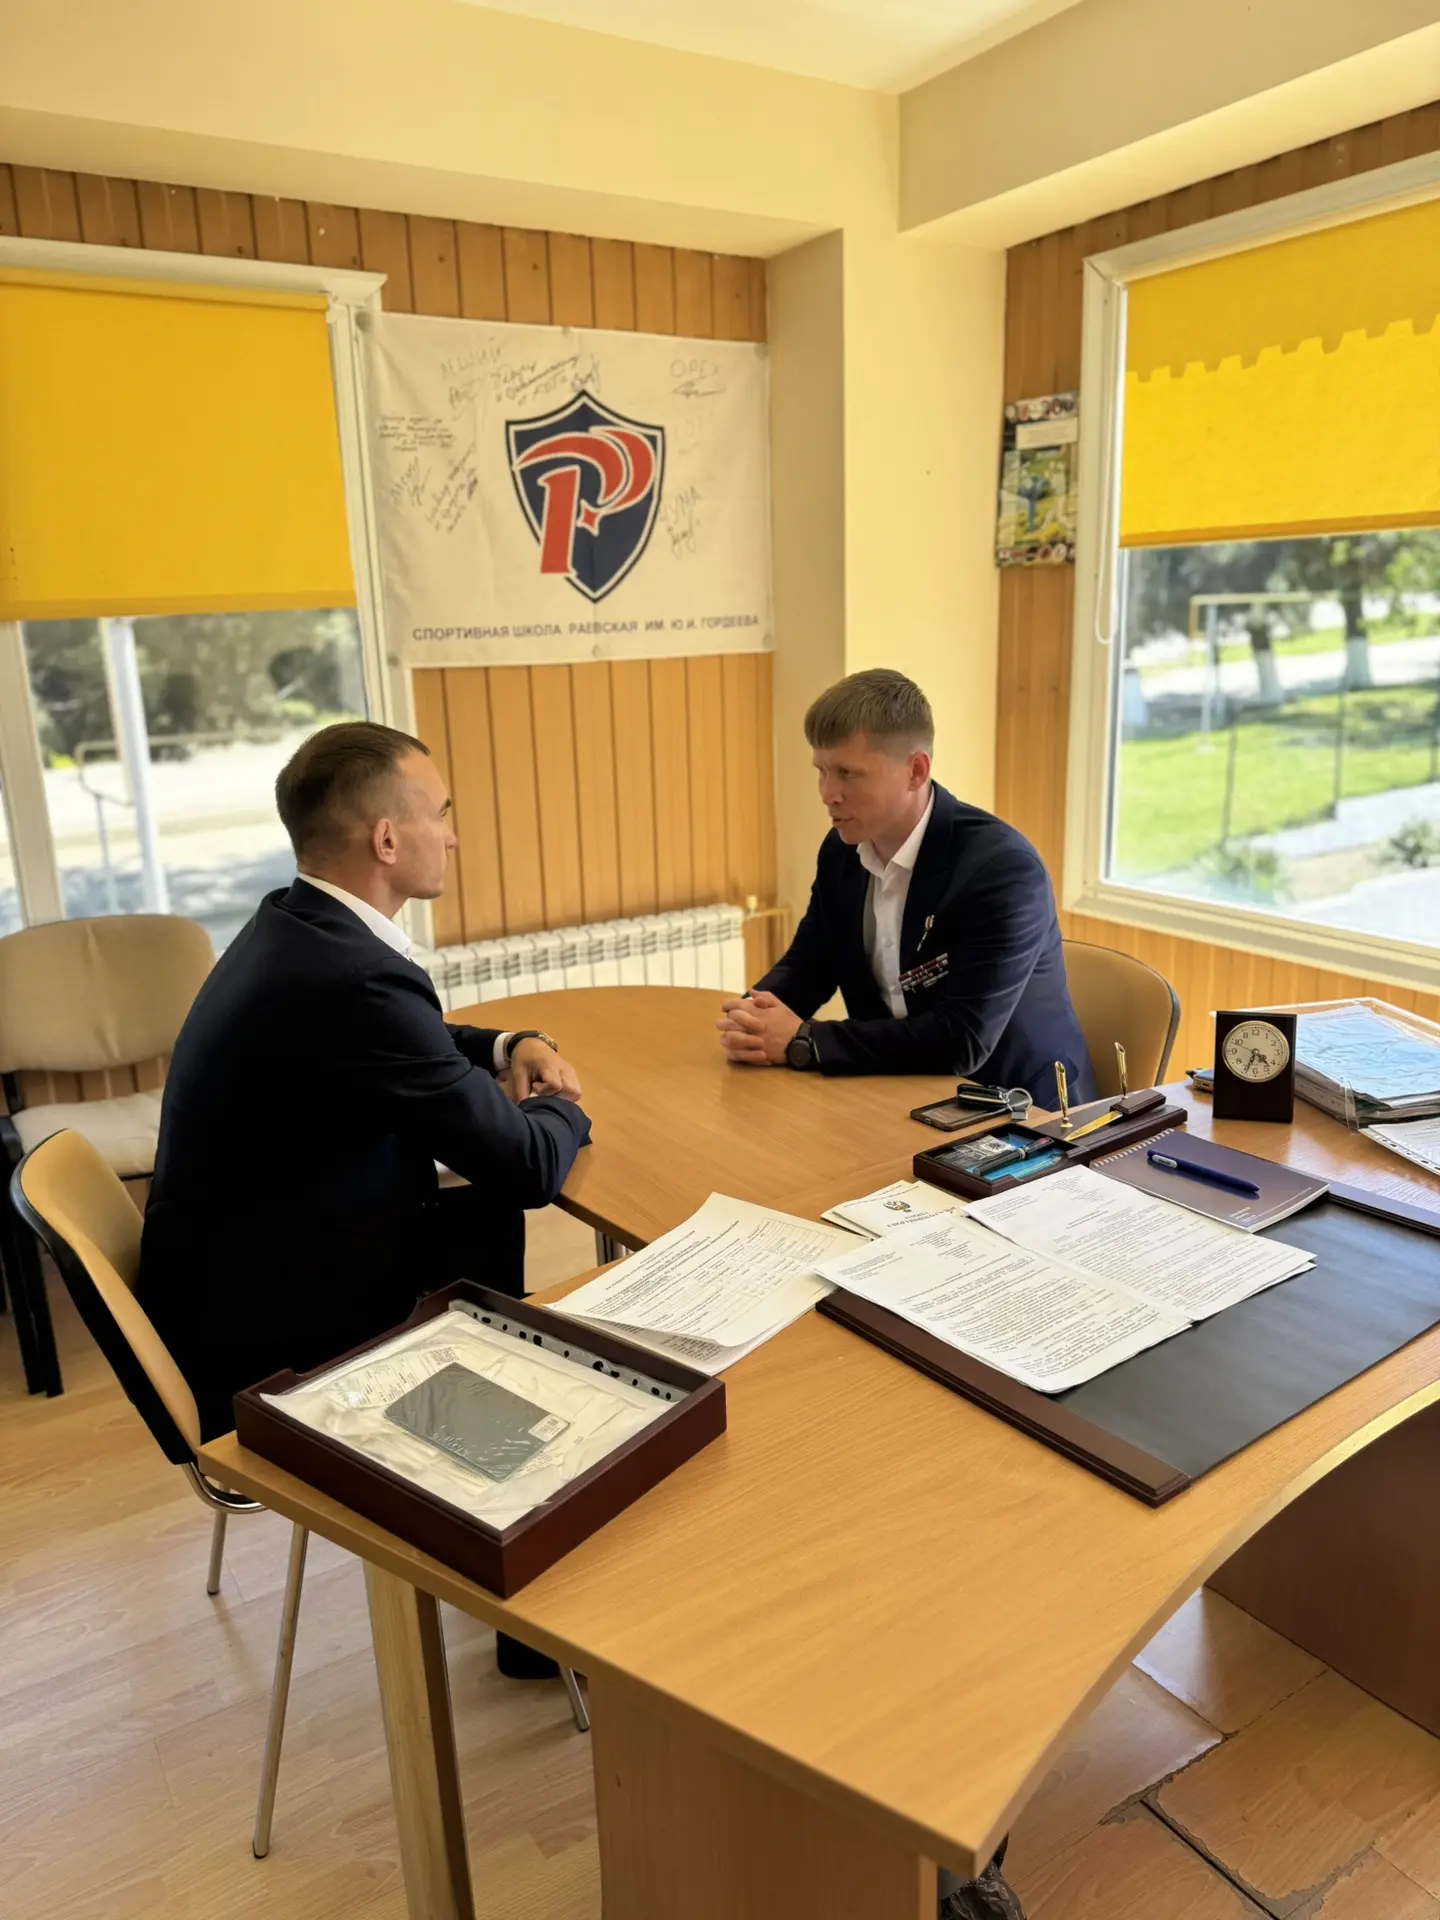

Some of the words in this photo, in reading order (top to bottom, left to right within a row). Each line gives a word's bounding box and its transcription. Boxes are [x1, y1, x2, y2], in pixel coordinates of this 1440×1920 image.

[412, 626, 510, 641] СПОРТИВНАЯ
[512, 624, 562, 638] ШКОЛА
[568, 620, 638, 635] РАЕВСКАЯ
[701, 614, 759, 630] ГОРДЕЕВА
